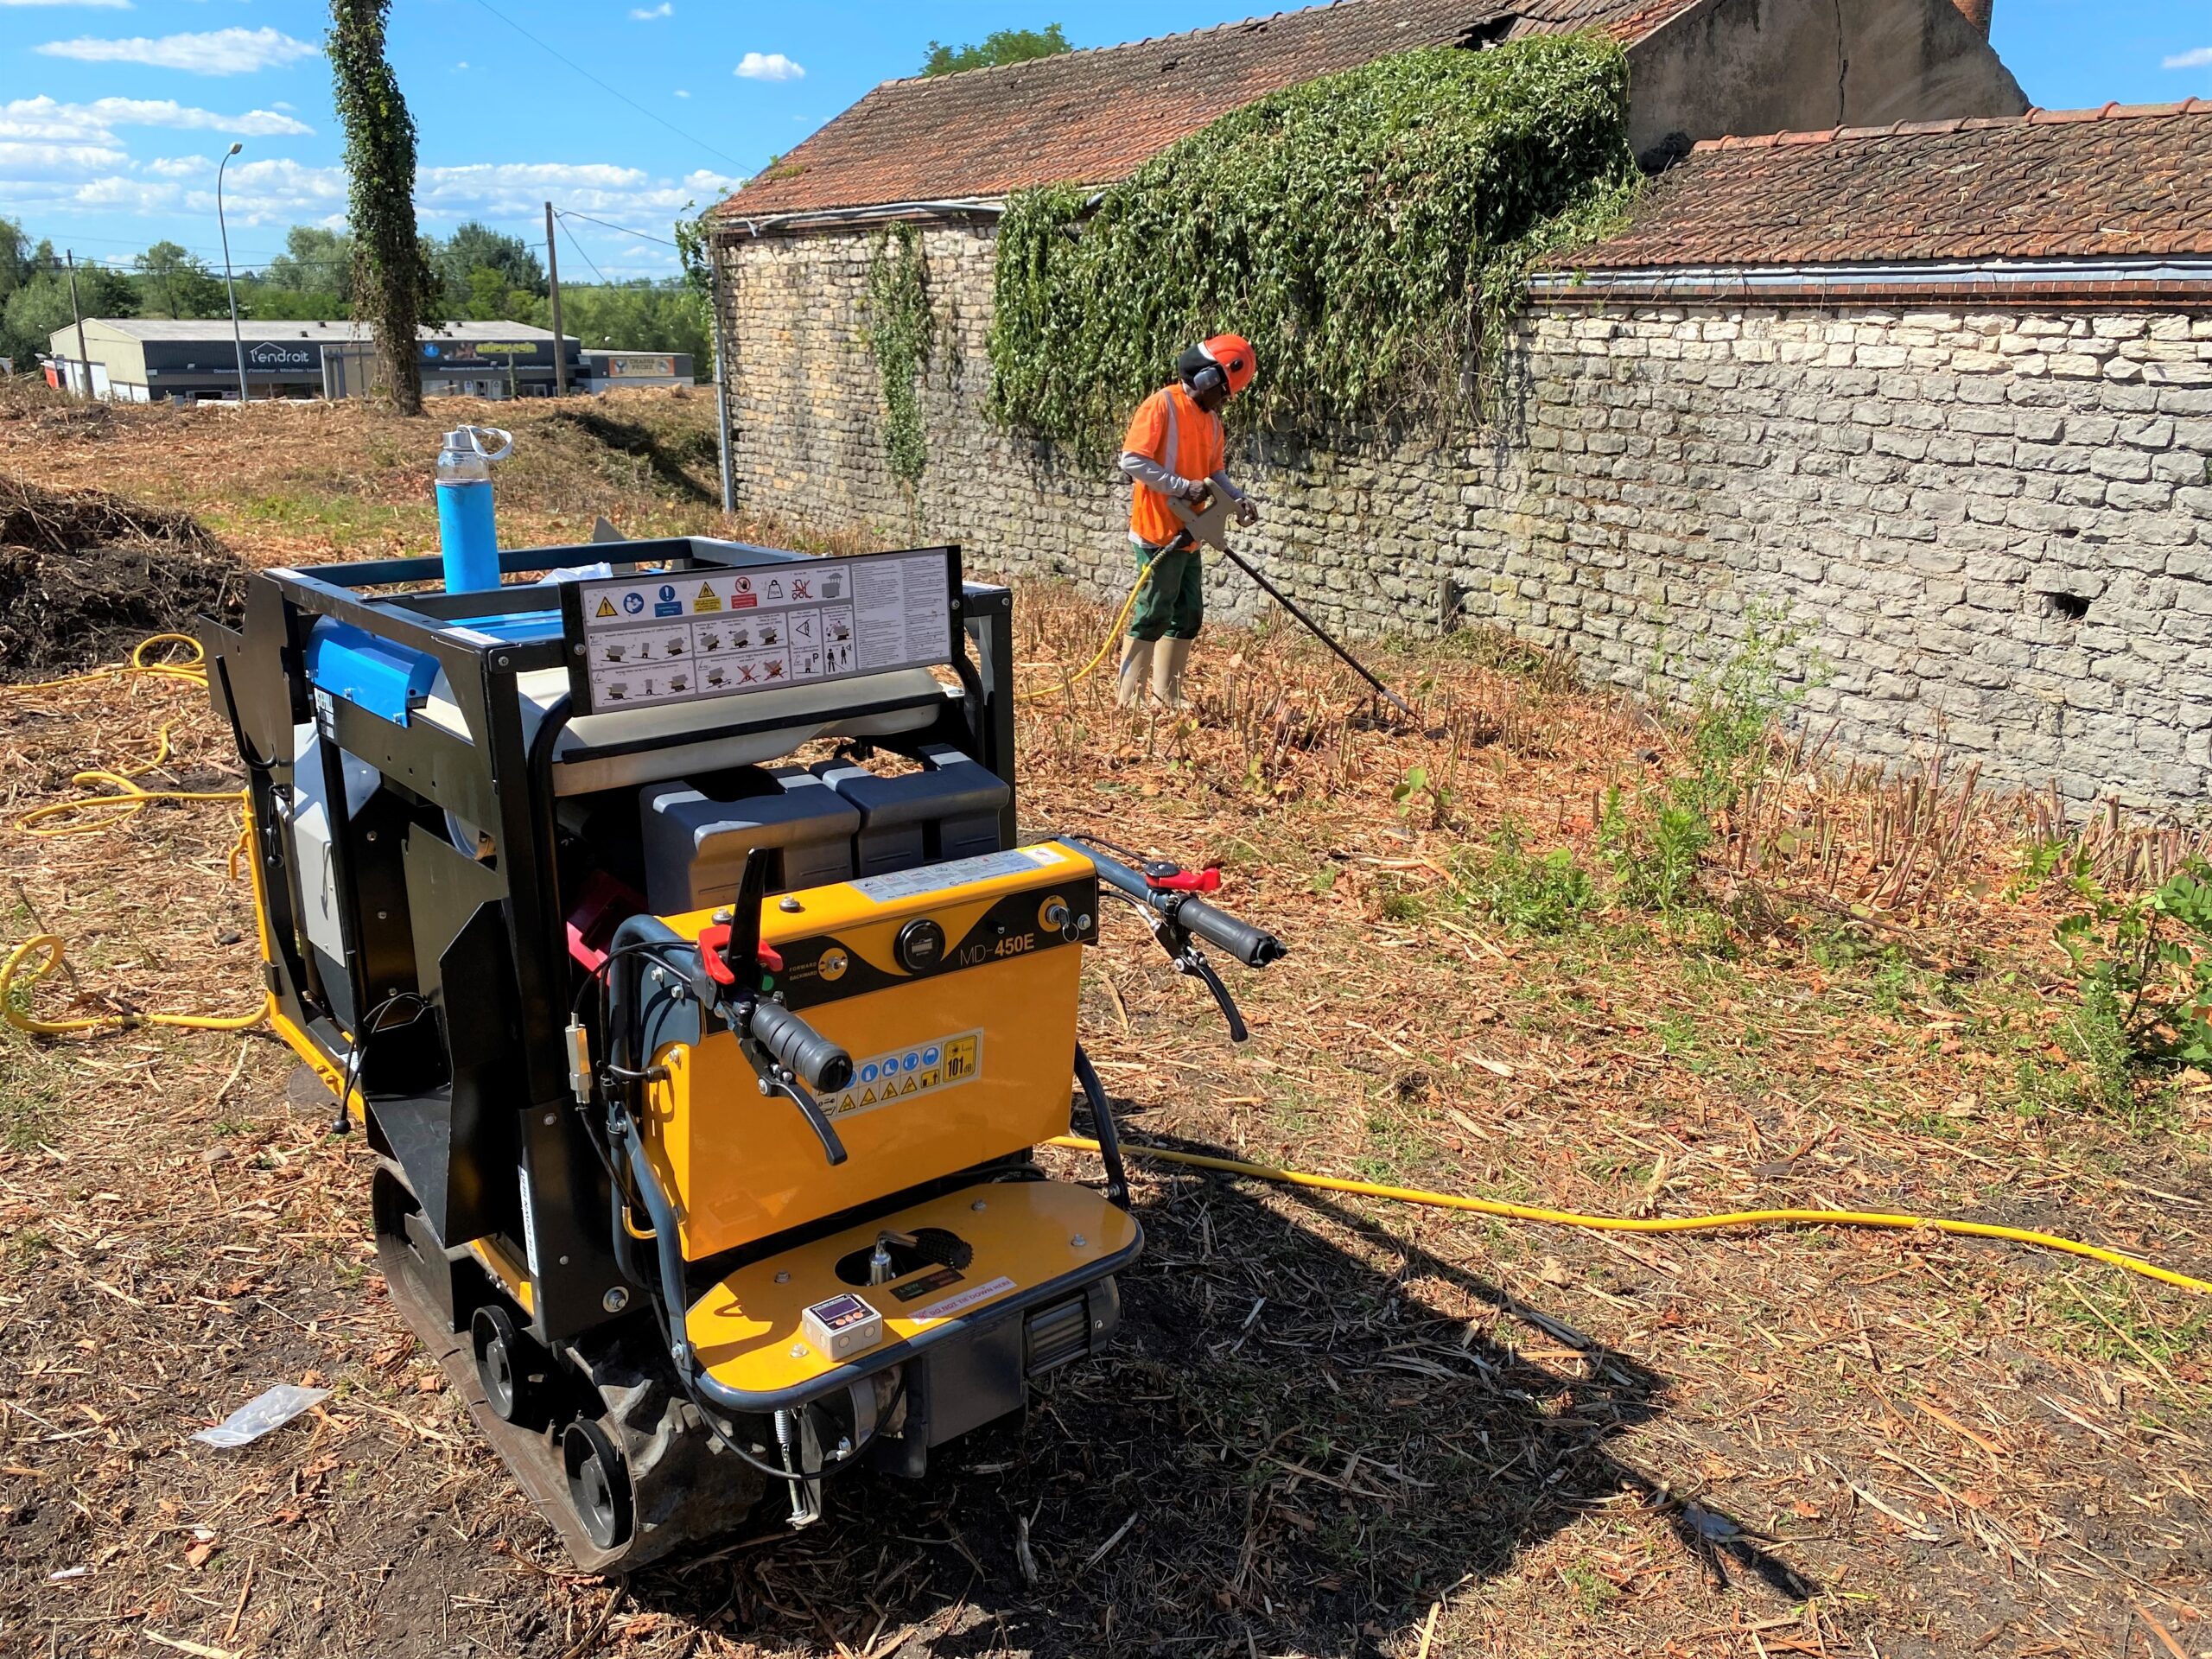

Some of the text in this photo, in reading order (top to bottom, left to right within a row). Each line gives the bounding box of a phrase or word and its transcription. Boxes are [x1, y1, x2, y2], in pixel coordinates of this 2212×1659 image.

[251, 349, 309, 363] l'endroit
[960, 933, 1034, 966] MD-450E
[789, 961, 817, 972] FORWARD
[789, 970, 817, 981] BACKWARD
[948, 1055, 963, 1077] 101
[899, 1283, 918, 1293] LOW
[969, 1287, 994, 1300] DOWN
[994, 1281, 1011, 1290] HERE
